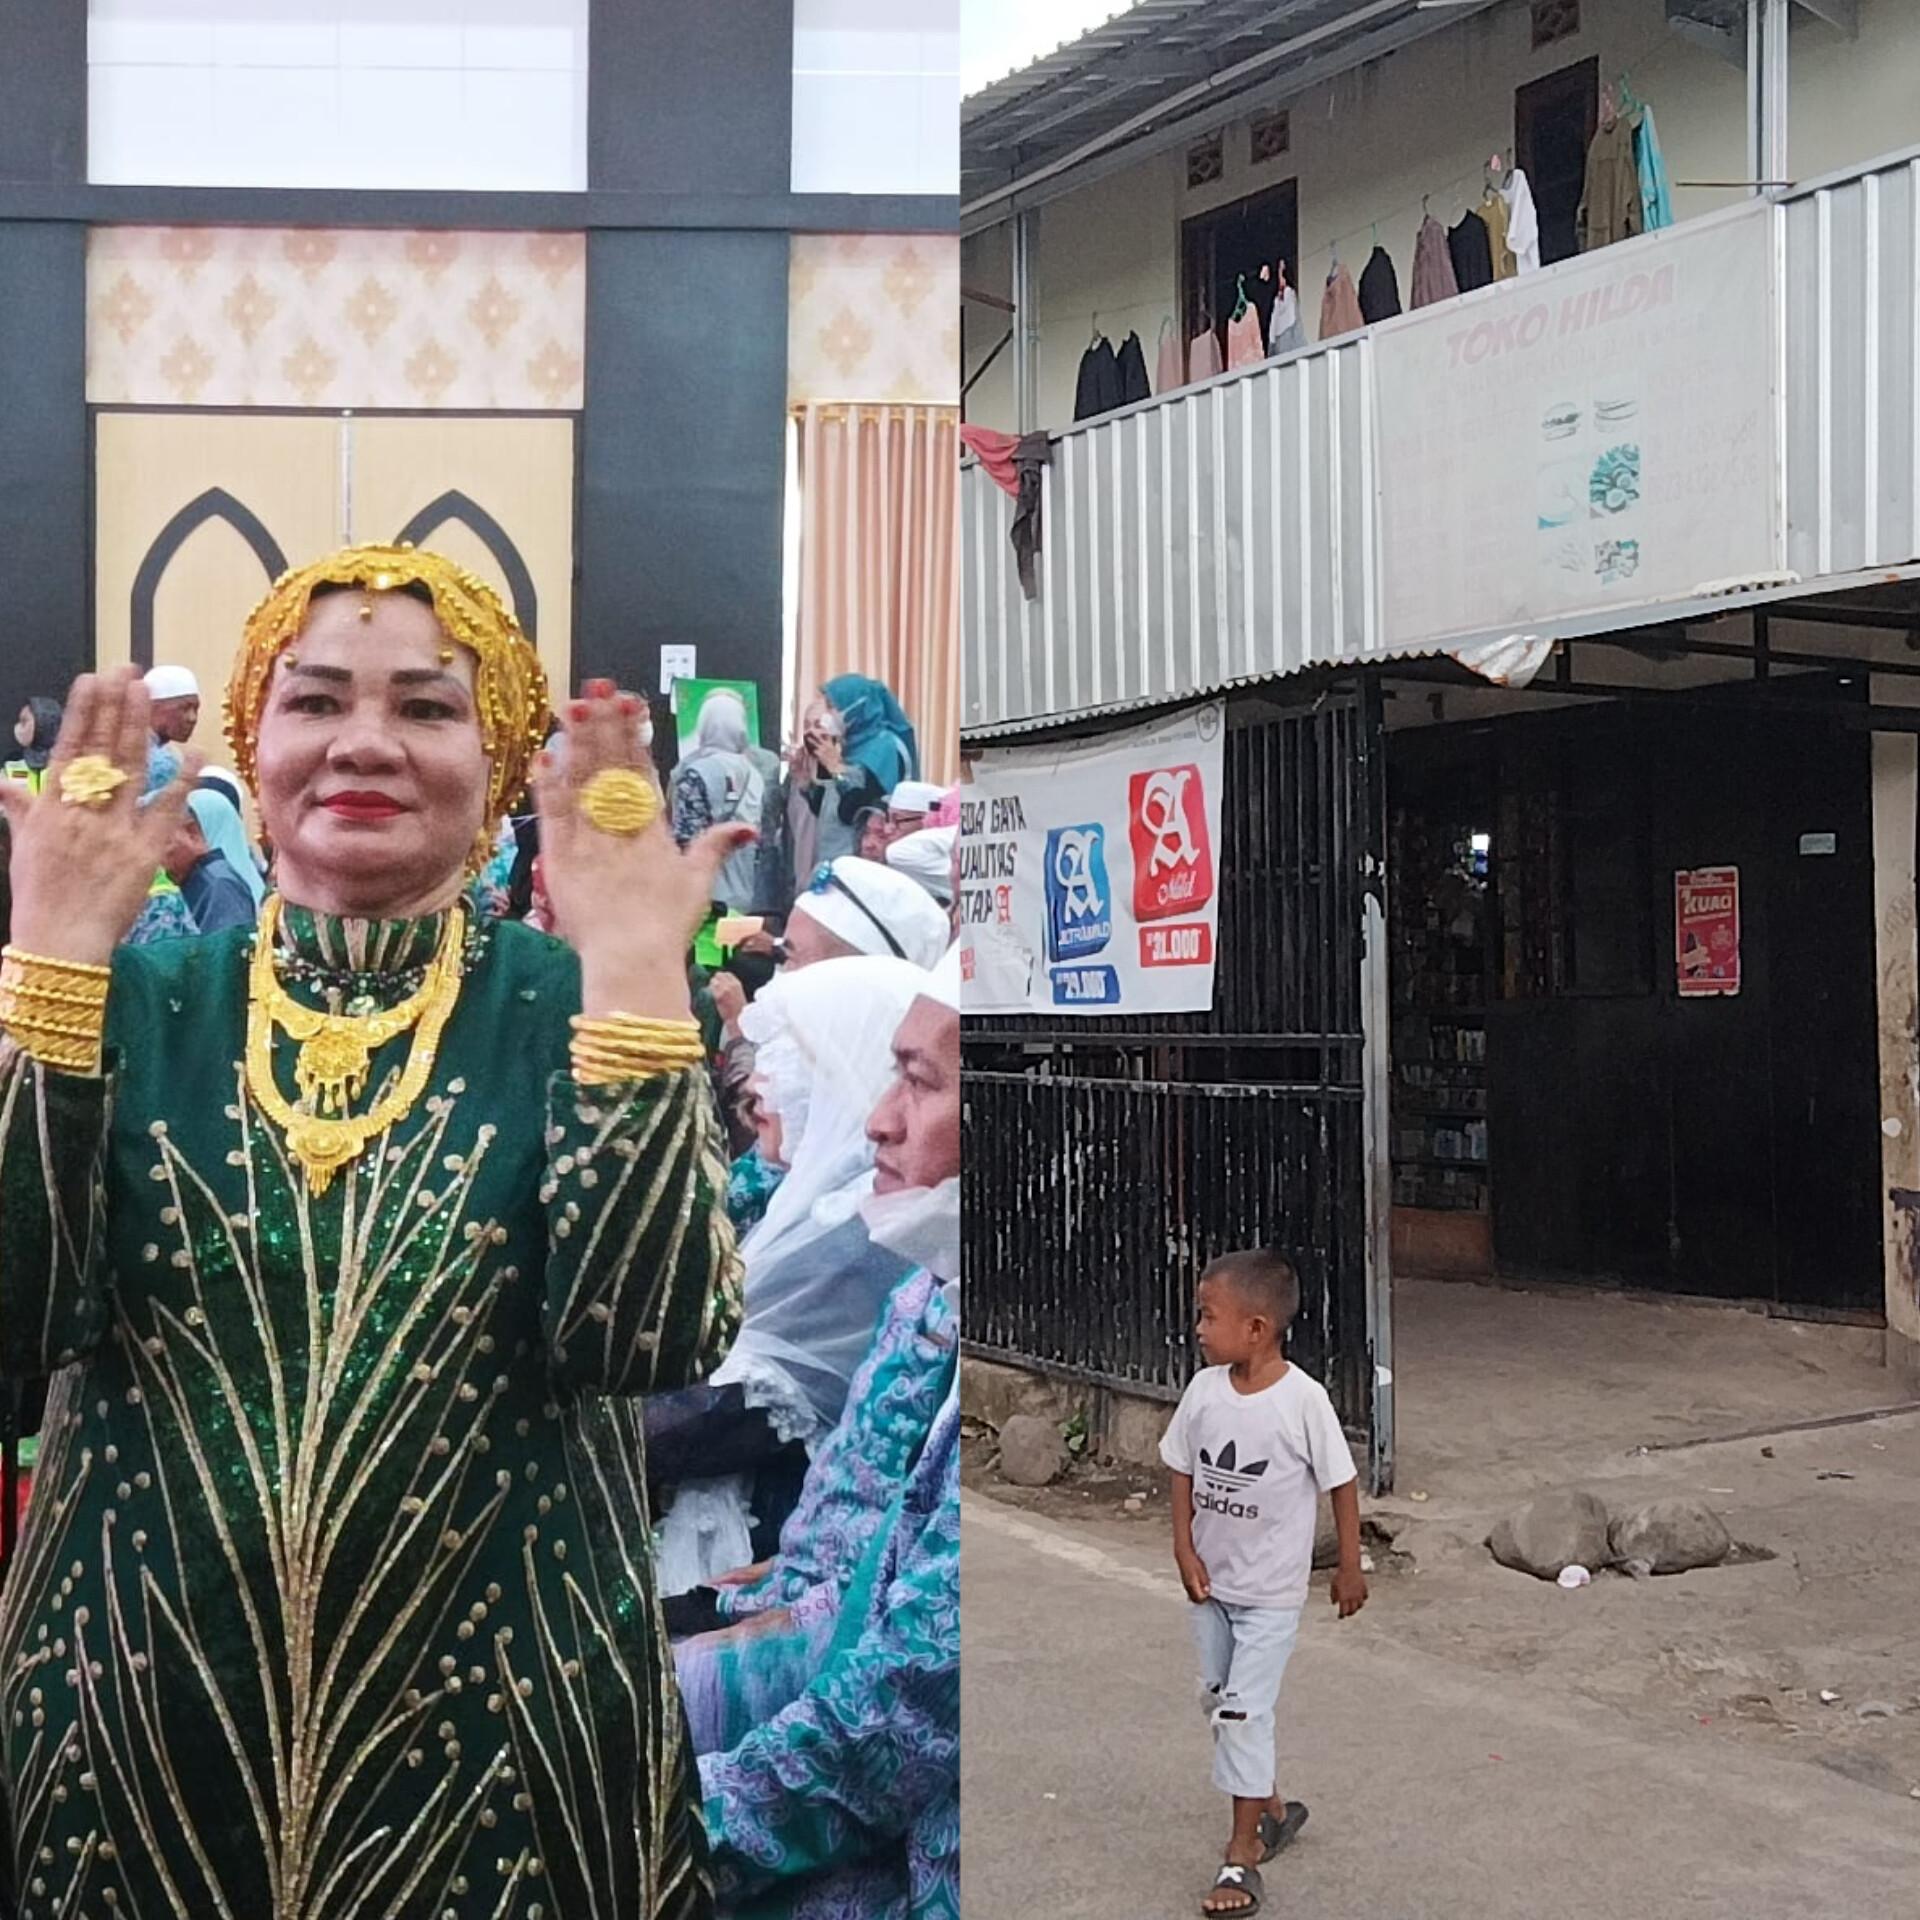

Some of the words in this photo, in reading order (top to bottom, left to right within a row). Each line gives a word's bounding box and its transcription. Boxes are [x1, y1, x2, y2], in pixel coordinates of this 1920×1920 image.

[1446, 303, 1549, 368] TOKO
[1557, 263, 1676, 336] HILDA
[991, 795, 1027, 834] GAYA
[960, 841, 1018, 881] UALITAS
